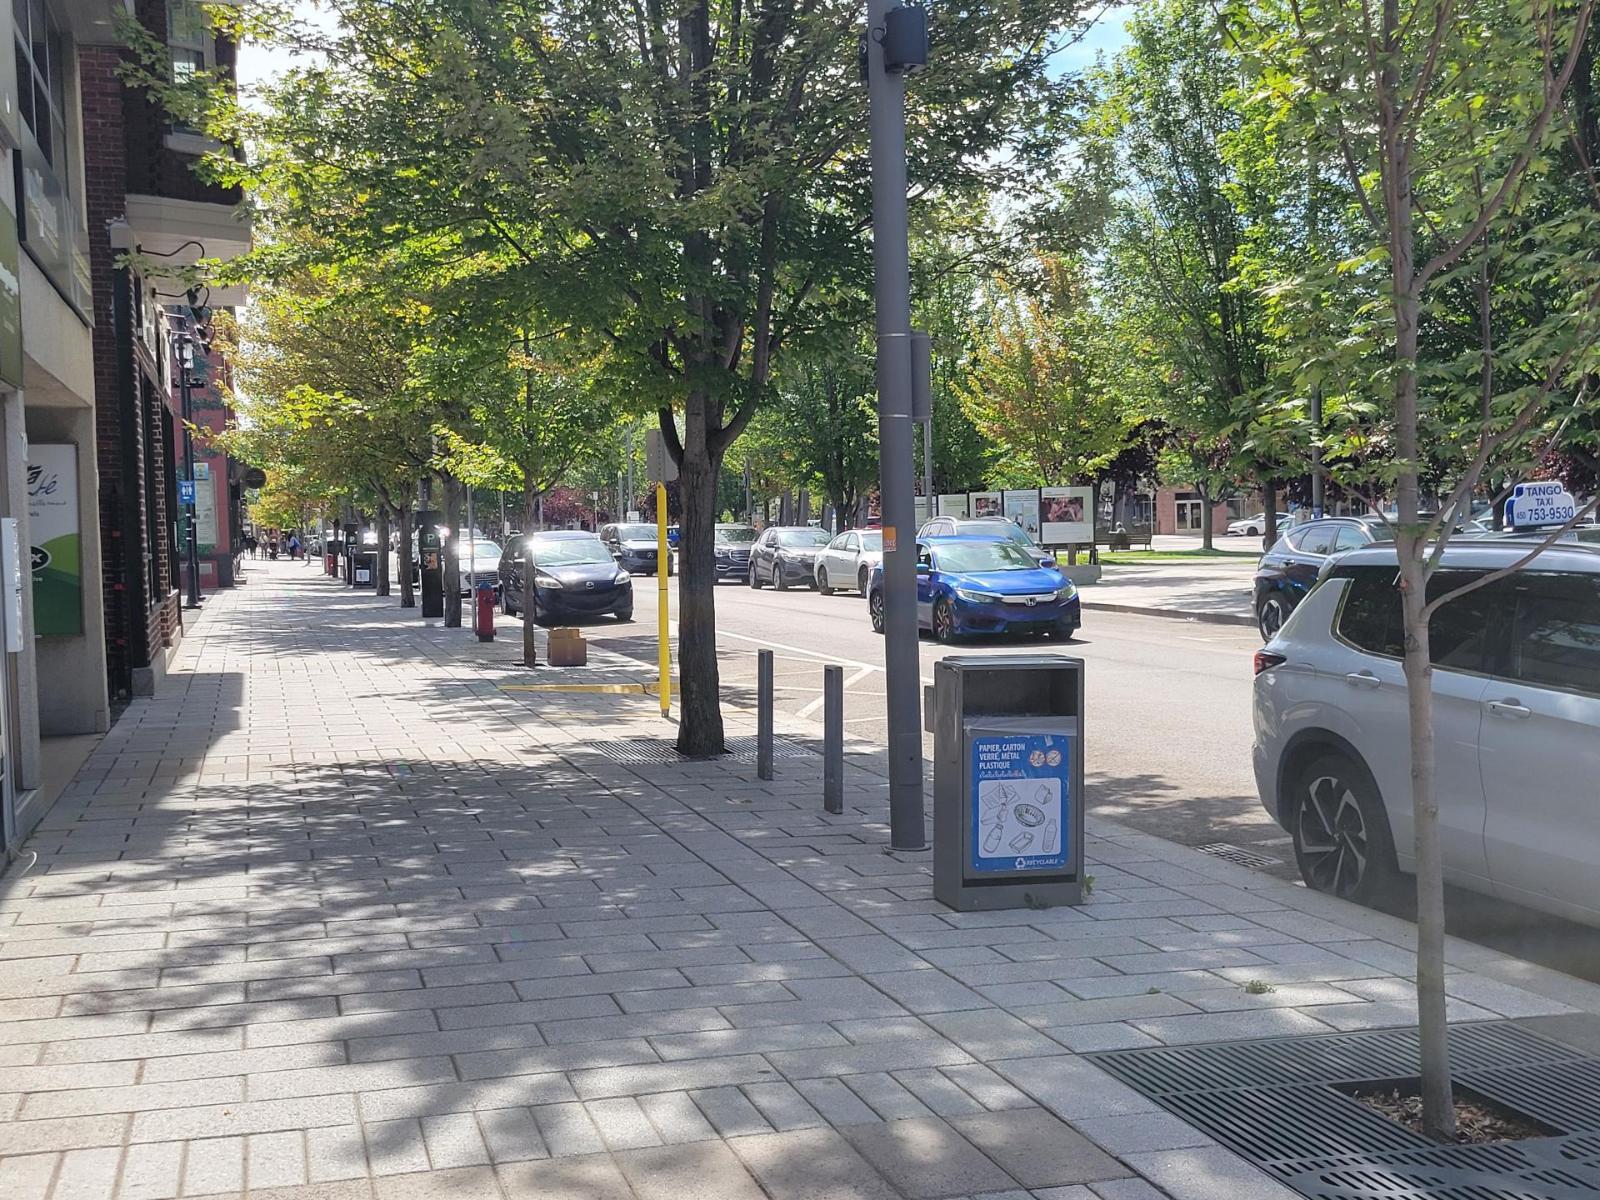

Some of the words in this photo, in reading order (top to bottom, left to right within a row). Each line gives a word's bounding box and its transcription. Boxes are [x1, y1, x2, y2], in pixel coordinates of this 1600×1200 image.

[1526, 486, 1562, 496] TANGO
[1536, 498, 1554, 506] TAXI
[1528, 506, 1574, 521] 753-9530
[427, 534, 435, 543] P
[1002, 743, 1025, 751] CARTON
[979, 761, 1010, 769] PLASTIQUE
